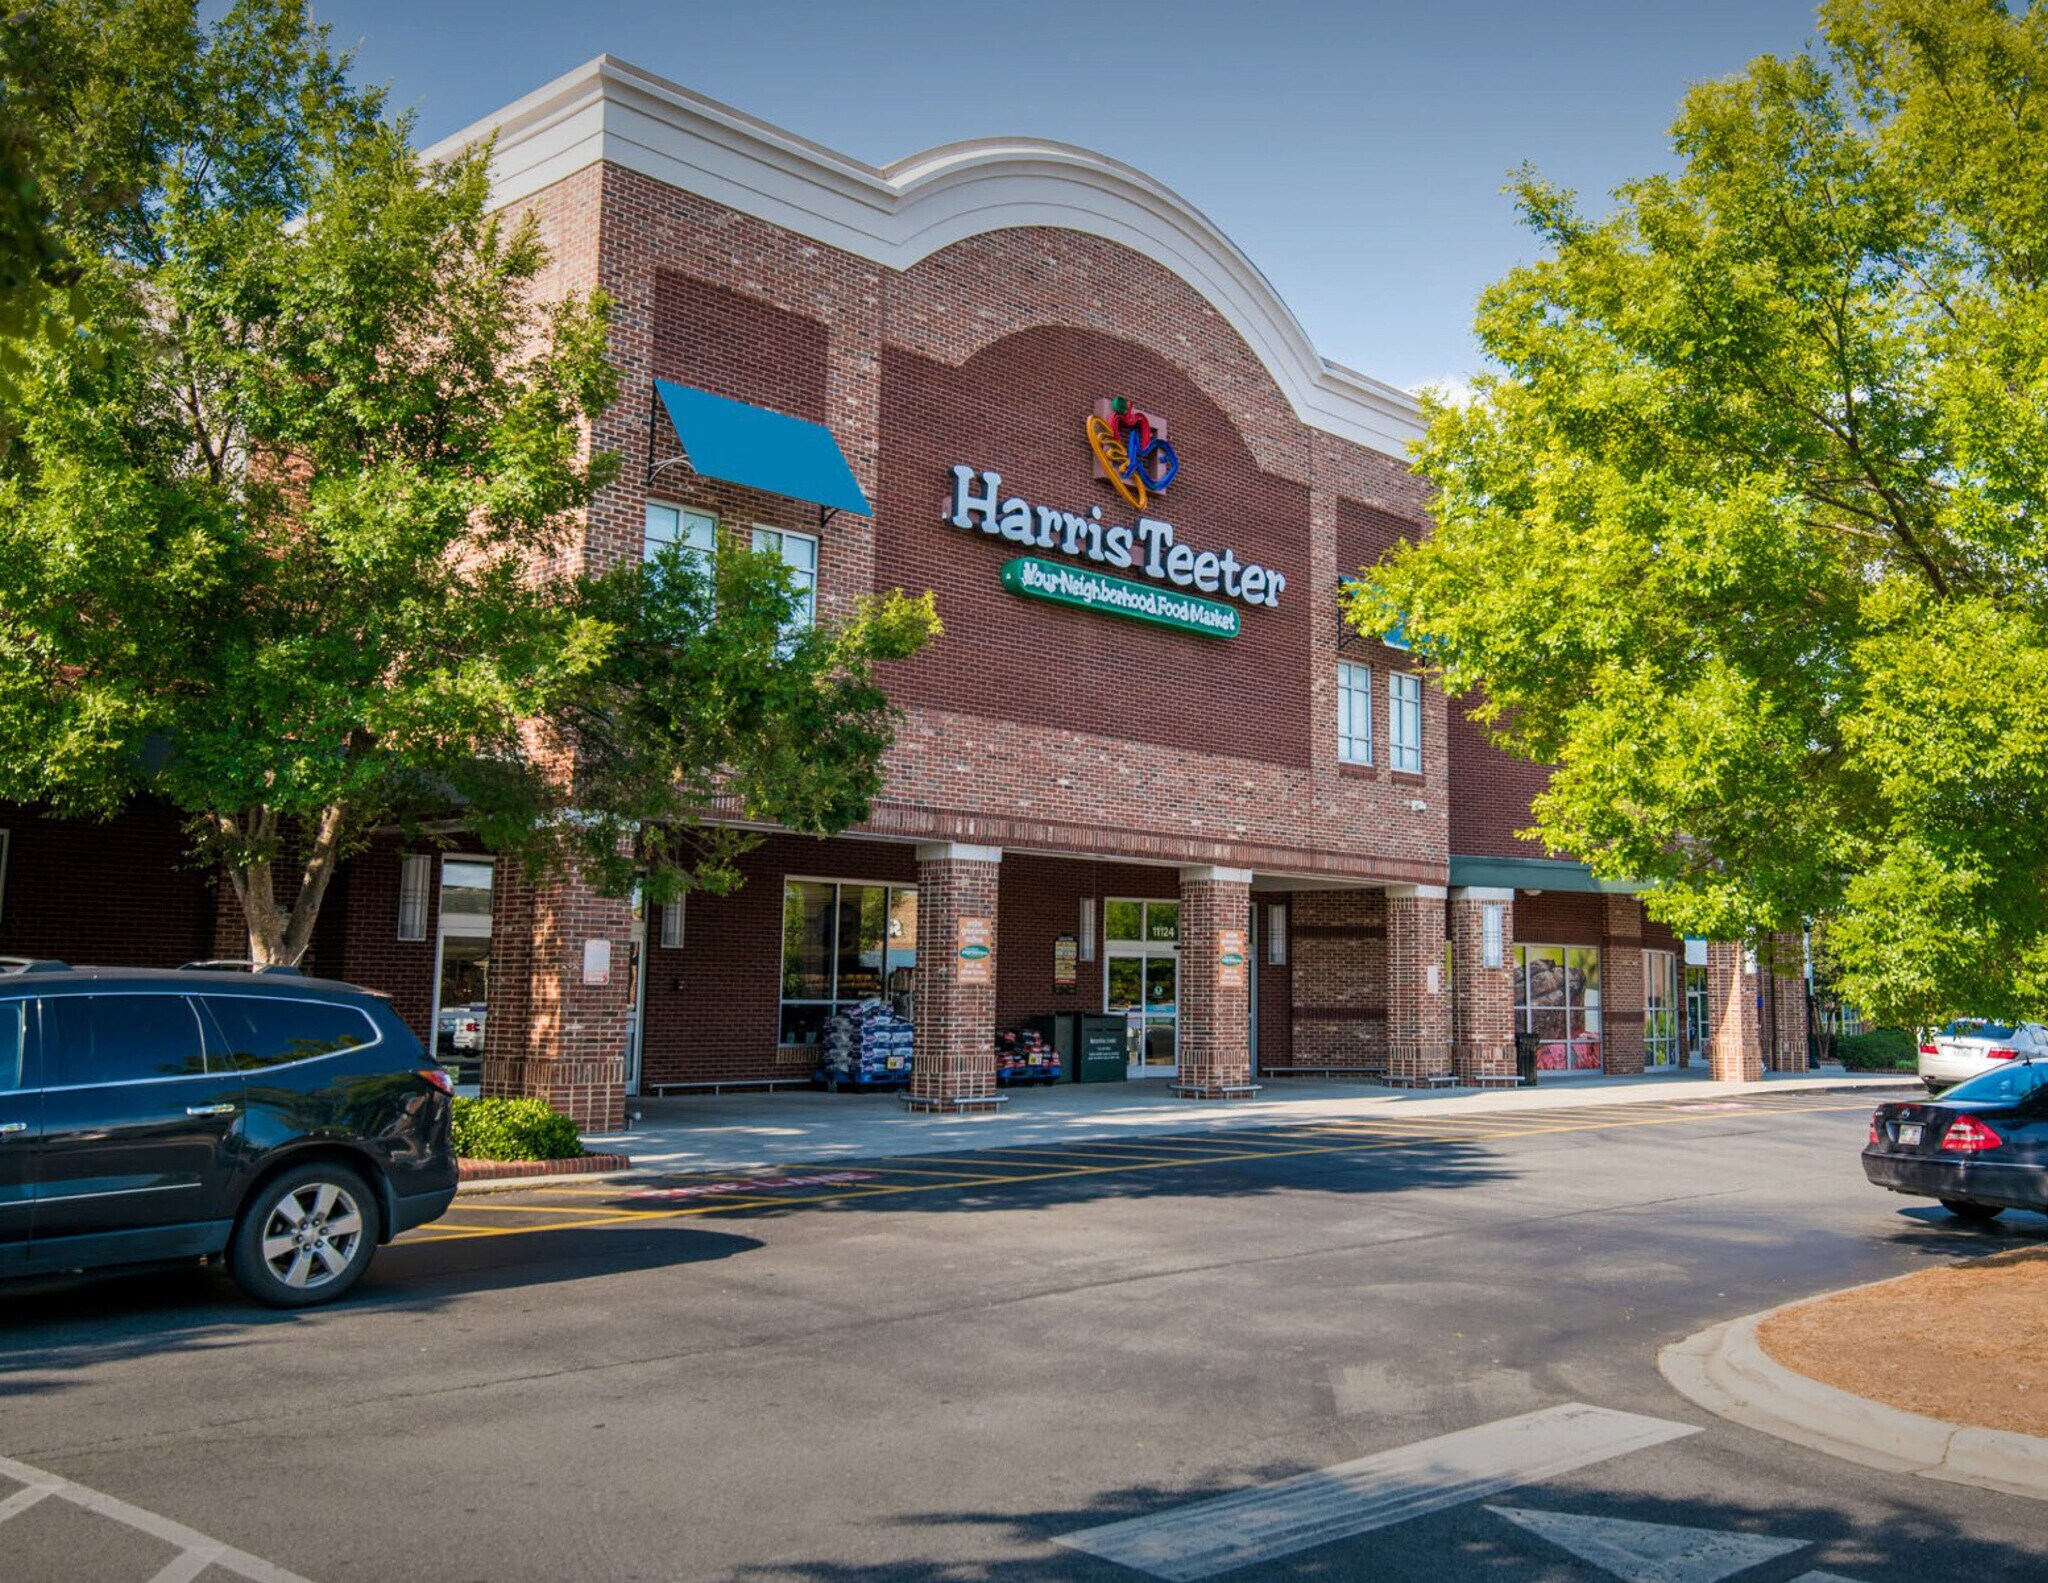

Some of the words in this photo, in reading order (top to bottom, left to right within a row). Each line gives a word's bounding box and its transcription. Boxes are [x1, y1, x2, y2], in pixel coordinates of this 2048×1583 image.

[951, 465, 1133, 568] Harris
[1139, 518, 1286, 607] Teeter
[1021, 561, 1061, 594] Your
[1060, 569, 1157, 614] Neighborhood
[1156, 596, 1189, 621] Food
[1190, 603, 1236, 631] Market
[1152, 926, 1175, 938] 11124
